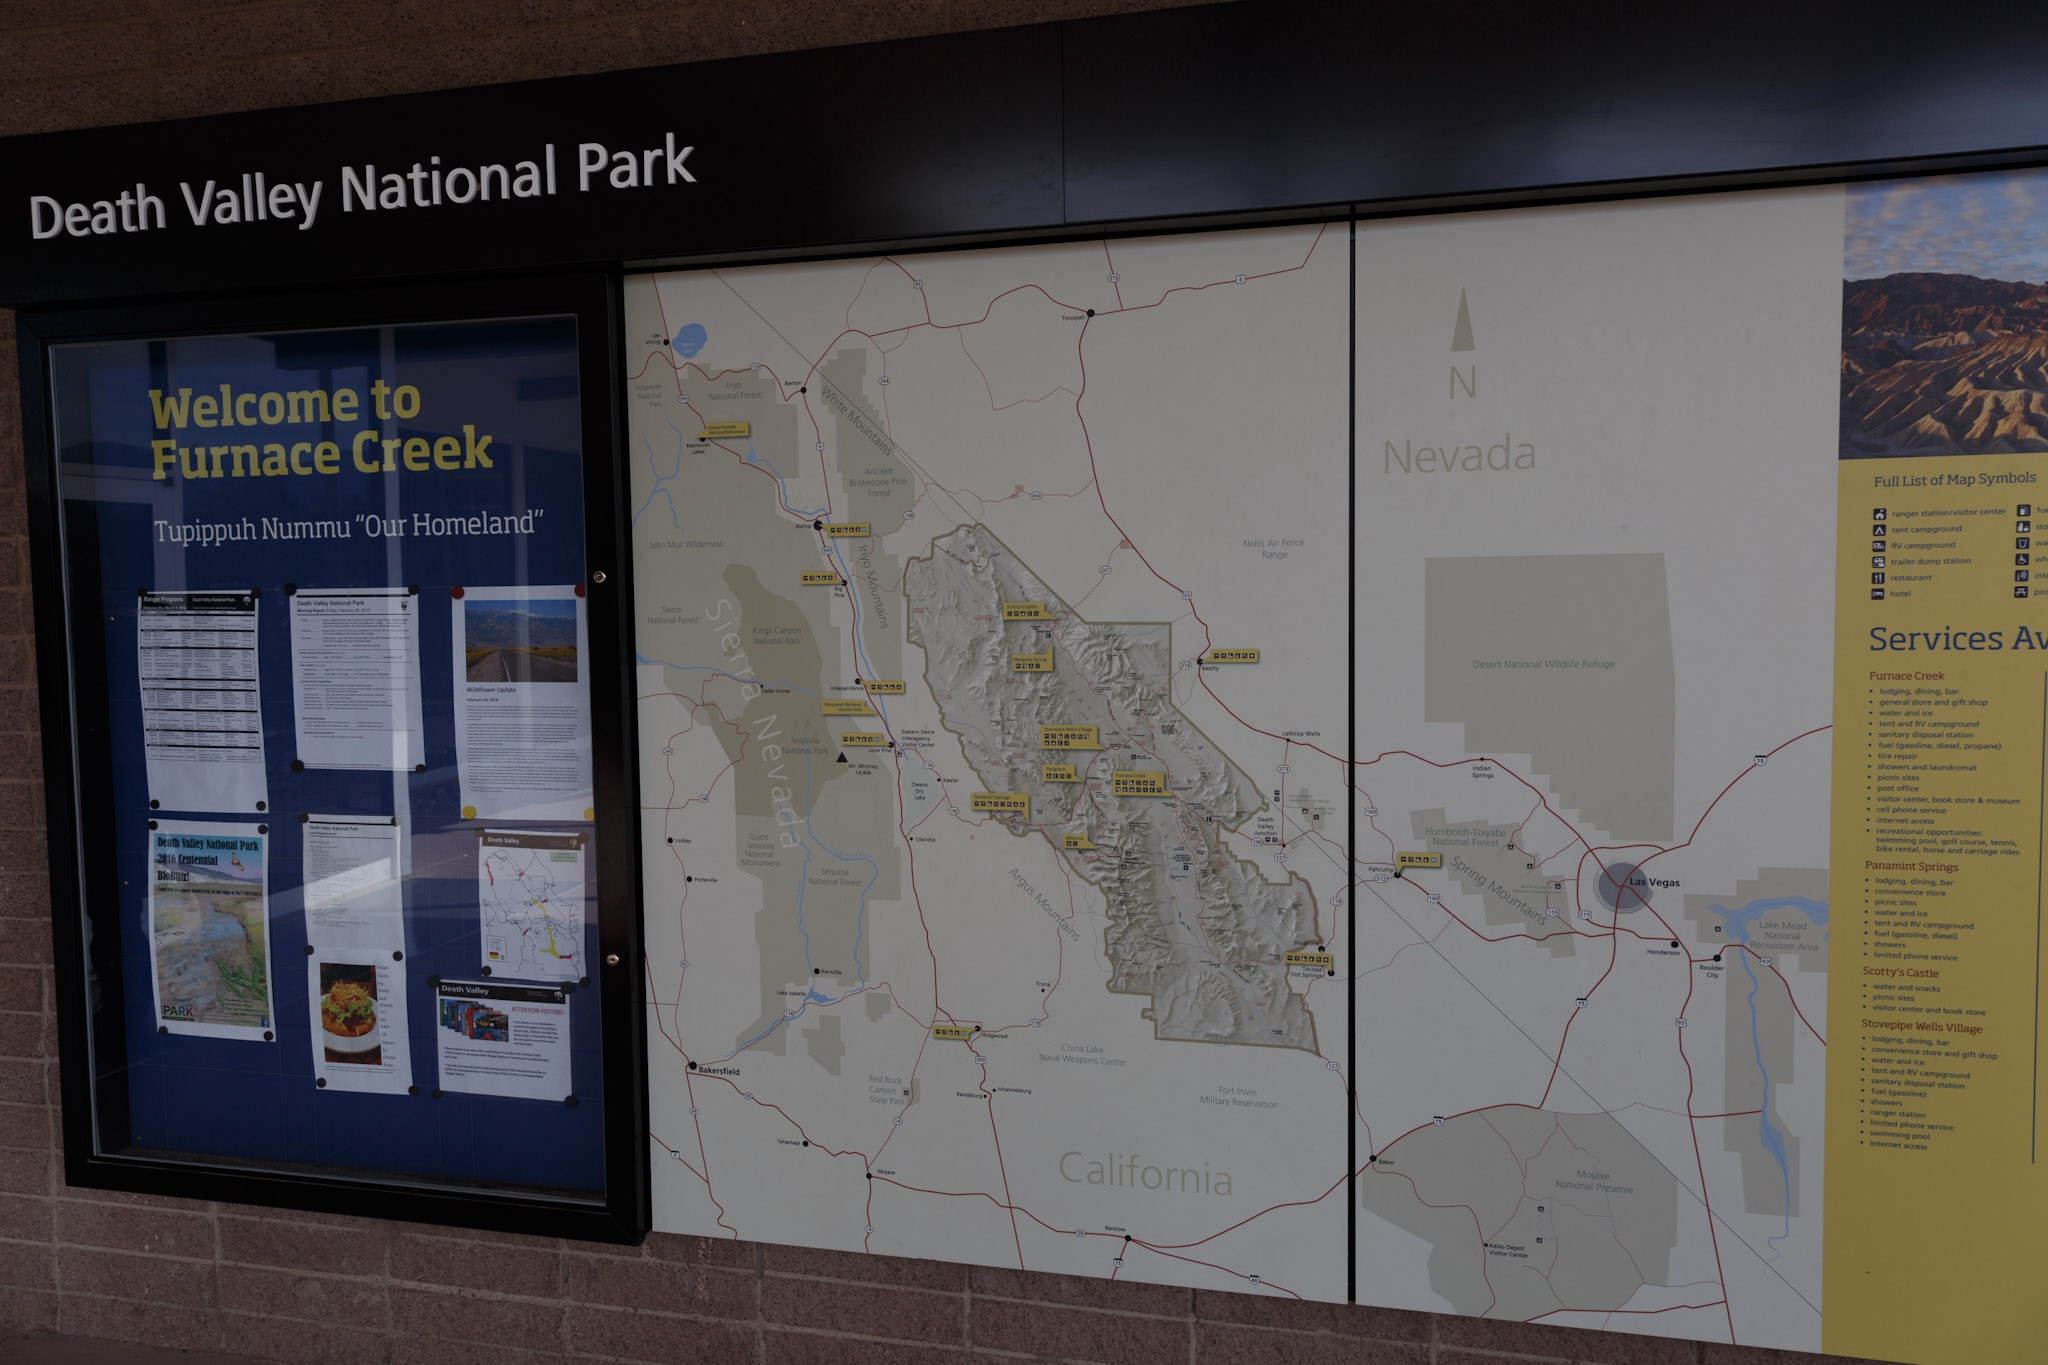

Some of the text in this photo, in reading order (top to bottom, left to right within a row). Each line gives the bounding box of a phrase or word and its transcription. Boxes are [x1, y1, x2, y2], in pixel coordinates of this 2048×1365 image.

[30, 132, 698, 240] Death Valley National Park
[1450, 365, 1477, 400] N
[149, 379, 421, 430] Welcome to
[822, 386, 894, 457] White Mountains
[152, 424, 493, 480] Furnace Creek
[1384, 433, 1536, 475] Nevada
[1874, 472, 2037, 487] Full List of Map Symbols
[1921, 509, 1977, 517] station/visitor
[155, 509, 544, 547] Tupippuh Nummu “Our Homeland”
[1911, 526, 1962, 534] campground
[650, 540, 723, 549] John Muir Wilderness
[1243, 539, 1304, 548] Nellis Air Force
[1905, 542, 1956, 550] campground
[1262, 551, 1288, 560] Range
[1918, 558, 1941, 566] dump
[858, 545, 888, 629] Inyo Mountains
[753, 627, 801, 636] Kings Canyon
[1870, 626, 2003, 651] Services
[1473, 659, 1615, 670] Desert National Wildlife Refuge
[1870, 672, 1944, 681] Furnace Creek
[1880, 688, 1912, 696] lodging,
[1915, 688, 1943, 696] dining,
[1952, 699, 1967, 707] gift
[1969, 699, 1988, 707] shop
[705, 599, 805, 849] Sierra Nevada
[1425, 827, 1507, 838] Humboldt-Toiyabe
[157, 837, 259, 851] Death Valley National Park
[503, 838, 520, 846] Valley
[1433, 837, 1499, 847] National Forest
[157, 854, 218, 866] 2016 Centennial
[1369, 866, 1394, 874] Pahrump
[1865, 861, 1959, 873] Panamint Springs
[1630, 878, 1680, 888] Las Vegas
[1451, 856, 1547, 926] Spring Mountains
[1009, 868, 1081, 942] Argus Mountains
[1760, 921, 1807, 930] Lake Mead
[1766, 931, 1801, 940] National
[1750, 941, 1819, 951] Recreation Area
[1907, 968, 1939, 978] Castle
[441, 984, 489, 997] Death Valley
[164, 1006, 193, 1017] PARK
[512, 1007, 539, 1015] ATTENTION
[1862, 1019, 1983, 1035] Stovepipe Wells Village
[1062, 1044, 1104, 1054] China Lake
[1039, 1053, 1127, 1066] Naval Weapons Center
[699, 1066, 740, 1076] Bakersfield
[885, 1076, 902, 1084] Rock
[869, 1086, 896, 1095] Canyon
[1219, 1086, 1257, 1096] Fort Irwin
[870, 1096, 905, 1106] State Park
[1201, 1096, 1279, 1109] Military Reservation
[1060, 1151, 1233, 1197] California
[1577, 1170, 1610, 1182] Mojave
[1556, 1180, 1634, 1194] National Preserve
[1508, 1244, 1524, 1252] Depot
